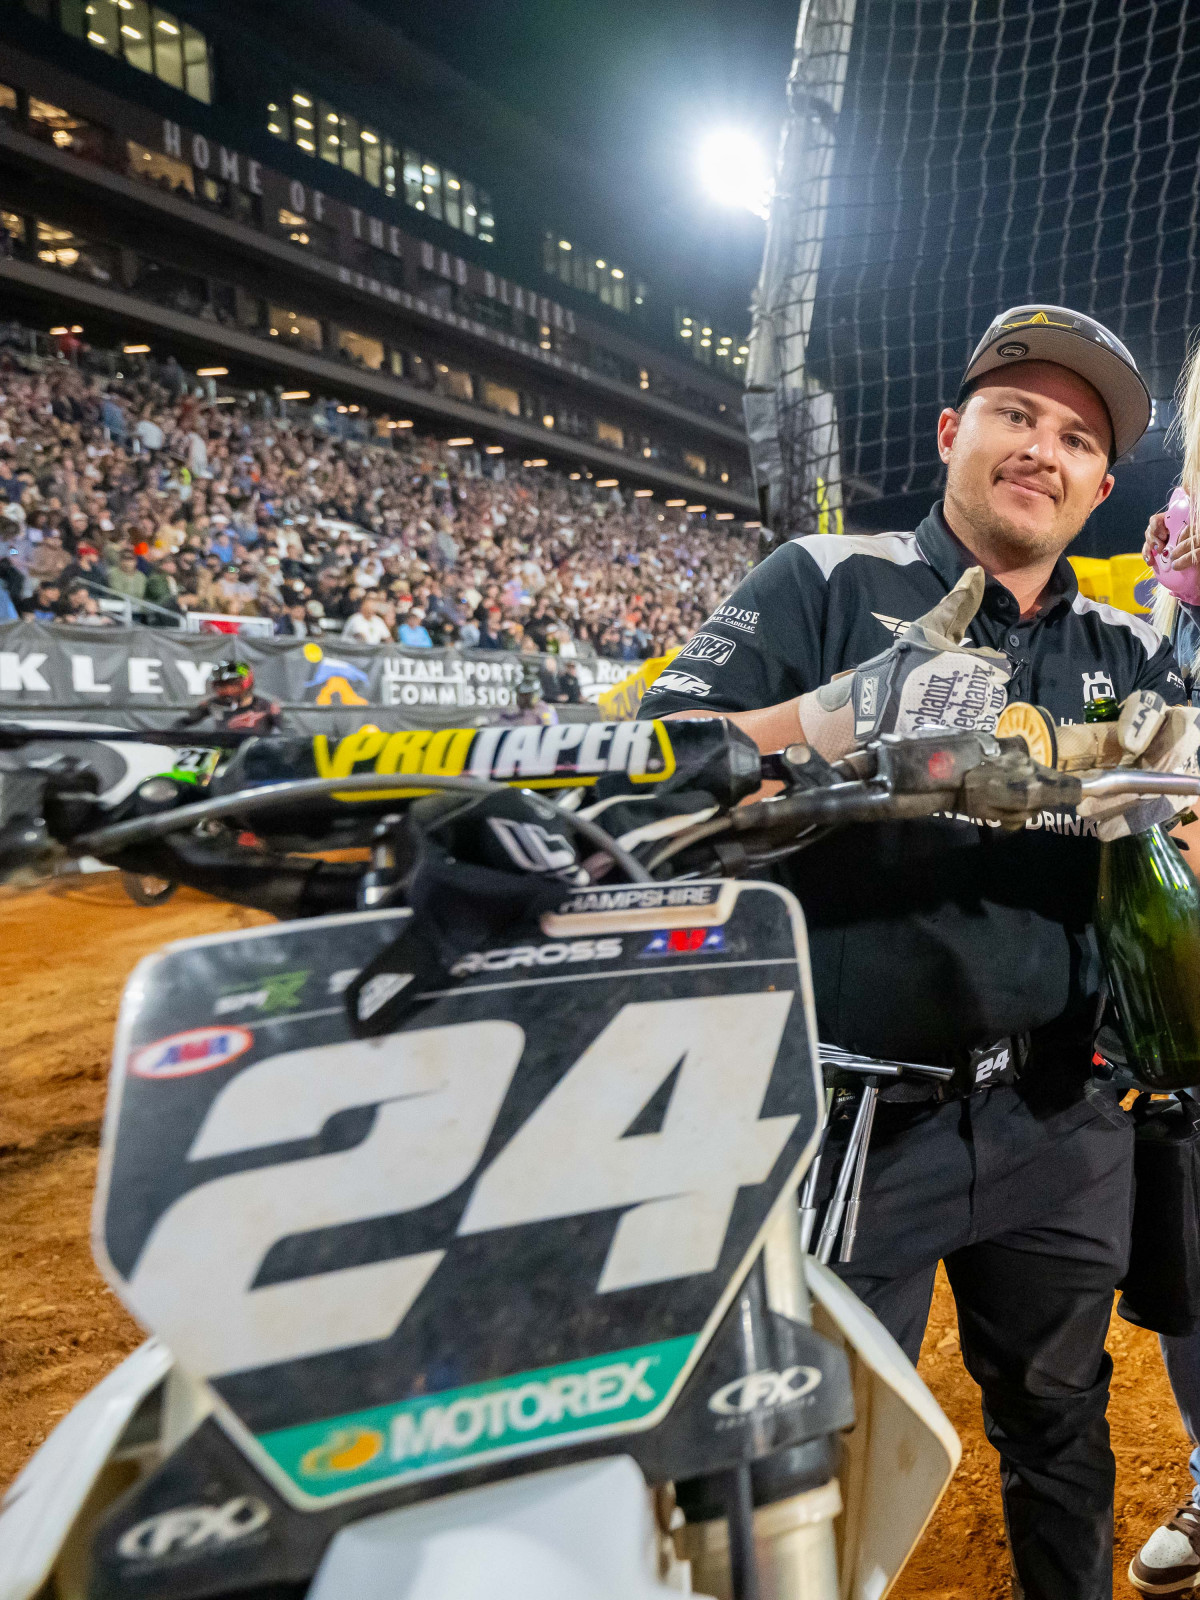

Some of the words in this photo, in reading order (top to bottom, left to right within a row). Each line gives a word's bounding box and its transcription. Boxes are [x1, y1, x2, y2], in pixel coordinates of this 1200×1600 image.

[163, 119, 264, 196] HOME
[383, 658, 444, 677] UTAH
[451, 660, 524, 685] SPORTS
[388, 683, 518, 705] COMMSSIO
[975, 1049, 1010, 1083] 24
[127, 990, 800, 1378] 24
[390, 1356, 656, 1460] MOTOREX
